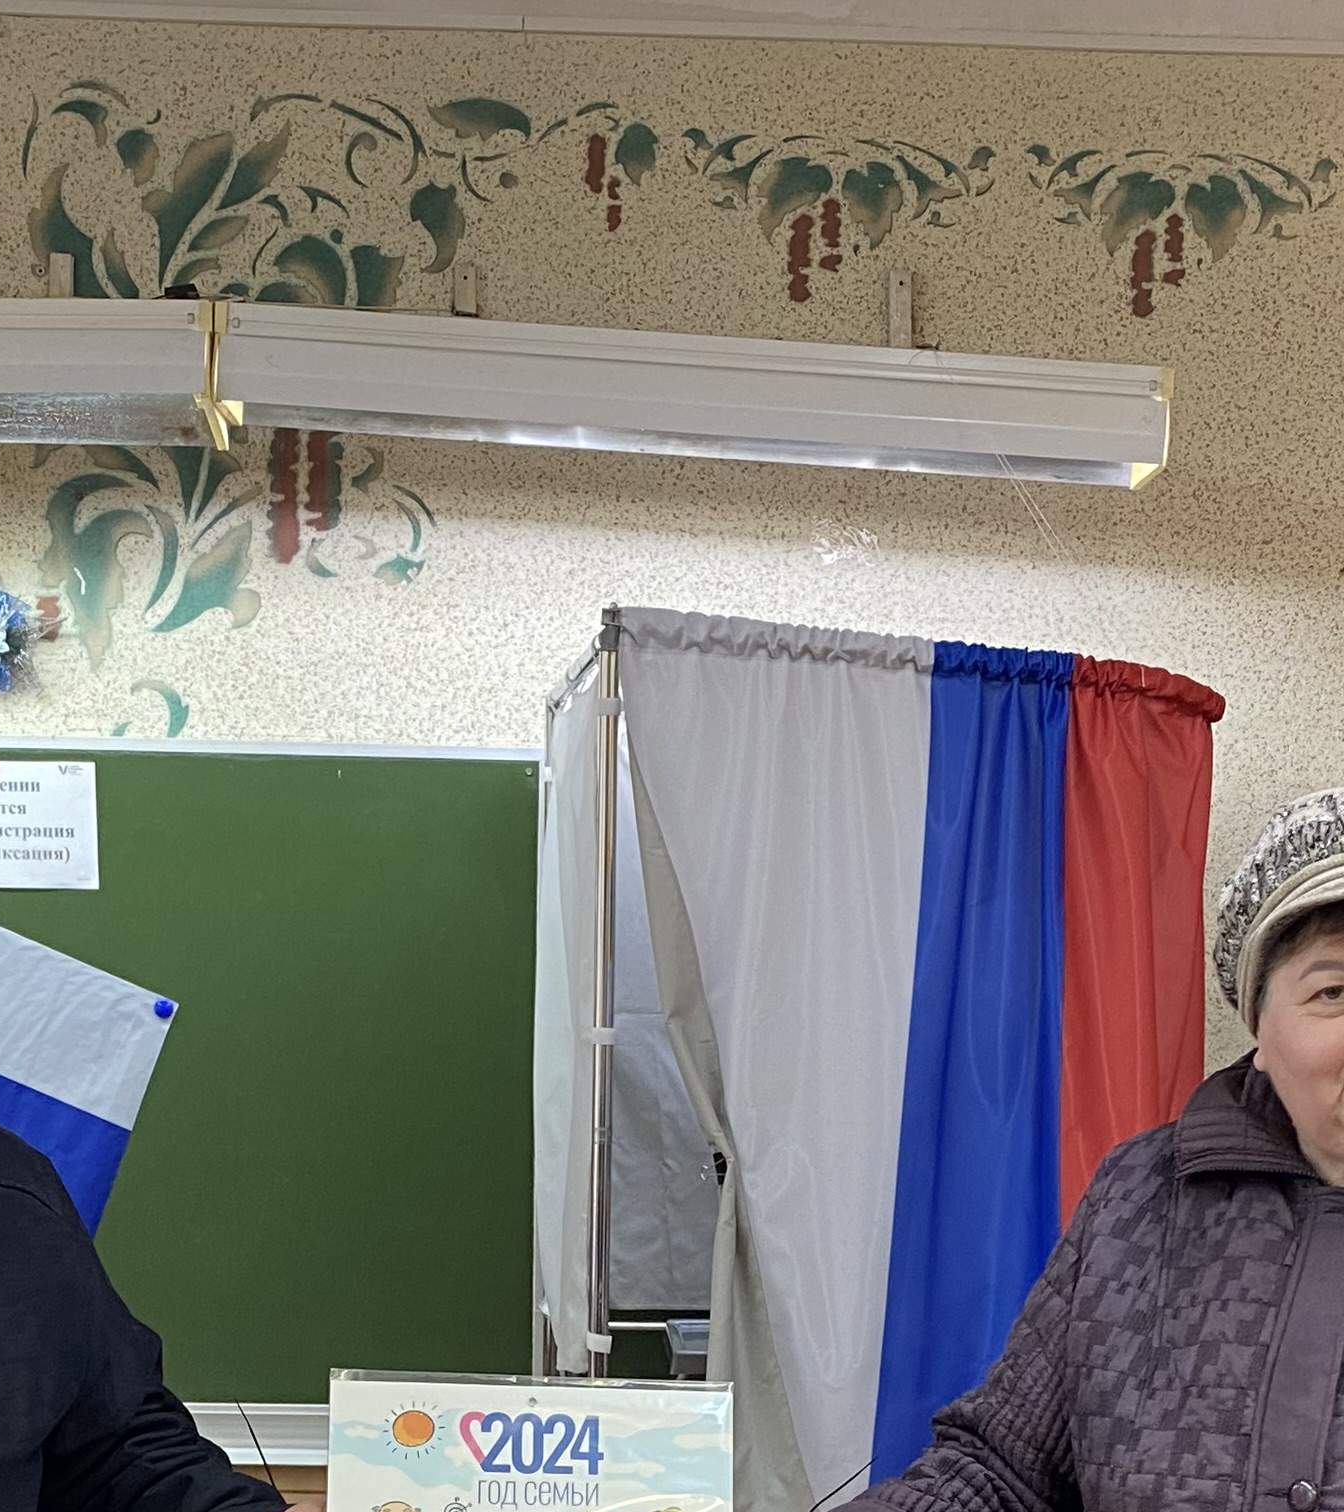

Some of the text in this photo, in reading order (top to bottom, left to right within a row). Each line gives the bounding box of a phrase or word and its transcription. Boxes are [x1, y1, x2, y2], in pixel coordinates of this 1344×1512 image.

[480, 1412, 604, 1475] 2024
[478, 1480, 599, 1510] ГОД СЕМЬИ
